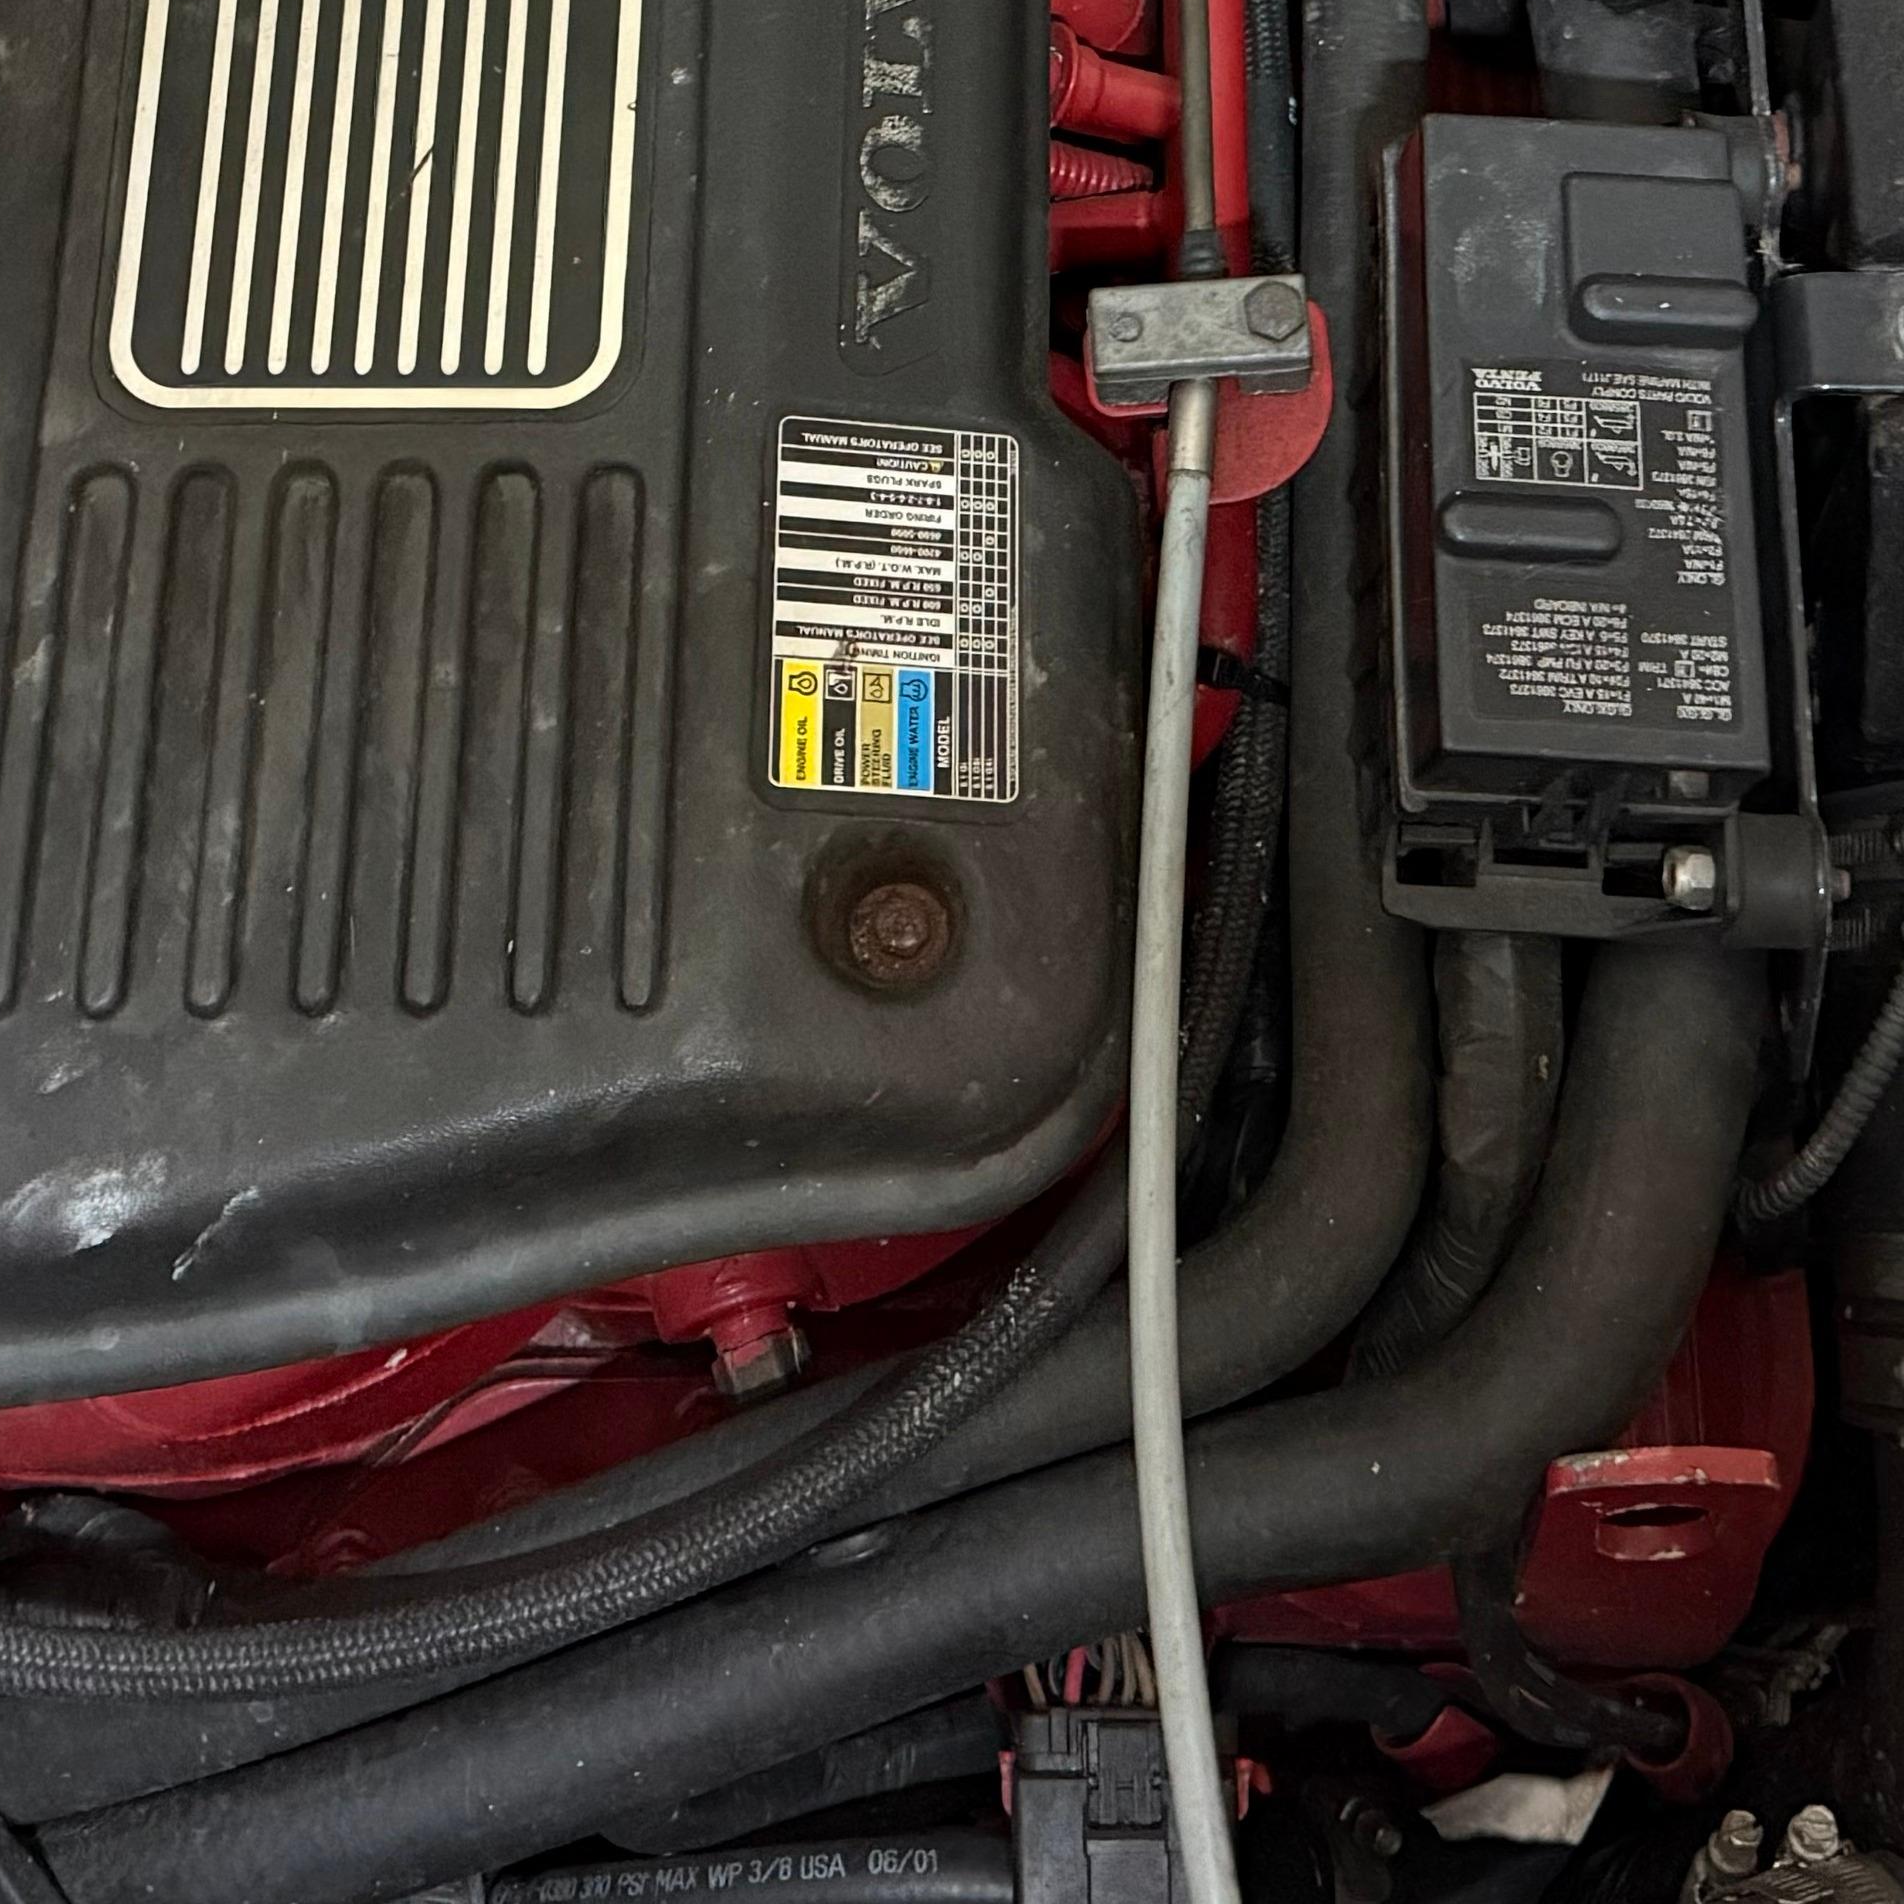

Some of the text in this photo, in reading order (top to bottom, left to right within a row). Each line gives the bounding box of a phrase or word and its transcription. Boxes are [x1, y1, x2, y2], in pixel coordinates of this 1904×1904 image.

[1471, 368, 1542, 381] PENTA
[1613, 373, 1636, 386] SAE
[1474, 379, 1542, 392] VOLVO
[1591, 386, 1711, 404] VOLVO PARTS COMPLY
[800, 432, 943, 454] SEE OPERATOR'S MANUAL
[866, 474, 942, 489] SPARK PLUGS
[865, 508, 942, 524] FIRING ORDER
[853, 576, 886, 588] FIXED
[853, 594, 885, 606] FIXED
[916, 617, 941, 627] IDLE
[796, 625, 844, 638] MANUAL
[846, 629, 916, 643] OPERATOR'S
[1532, 627, 1558, 639] SWT
[1560, 630, 1584, 641] KEY
[1690, 635, 1728, 648] START
[893, 650, 940, 663] IGNITION
[1548, 672, 1577, 684] TRIM
[1704, 680, 1730, 691] ACC
[1559, 687, 1584, 698] EVC
[1682, 693, 1692, 704] A
[909, 705, 920, 745] WATER
[937, 715, 951, 768] MODEL
[796, 716, 808, 781] ENGINE OIL
[833, 727, 846, 784] DRIVE OIL
[861, 743, 871, 785] POWER
[883, 753, 892, 787] FLUID
[654, 1866, 698, 1893] MAX
[706, 1864, 743, 1888] WP
[749, 1860, 793, 1884] 3/8
[799, 1854, 845, 1879] USA
